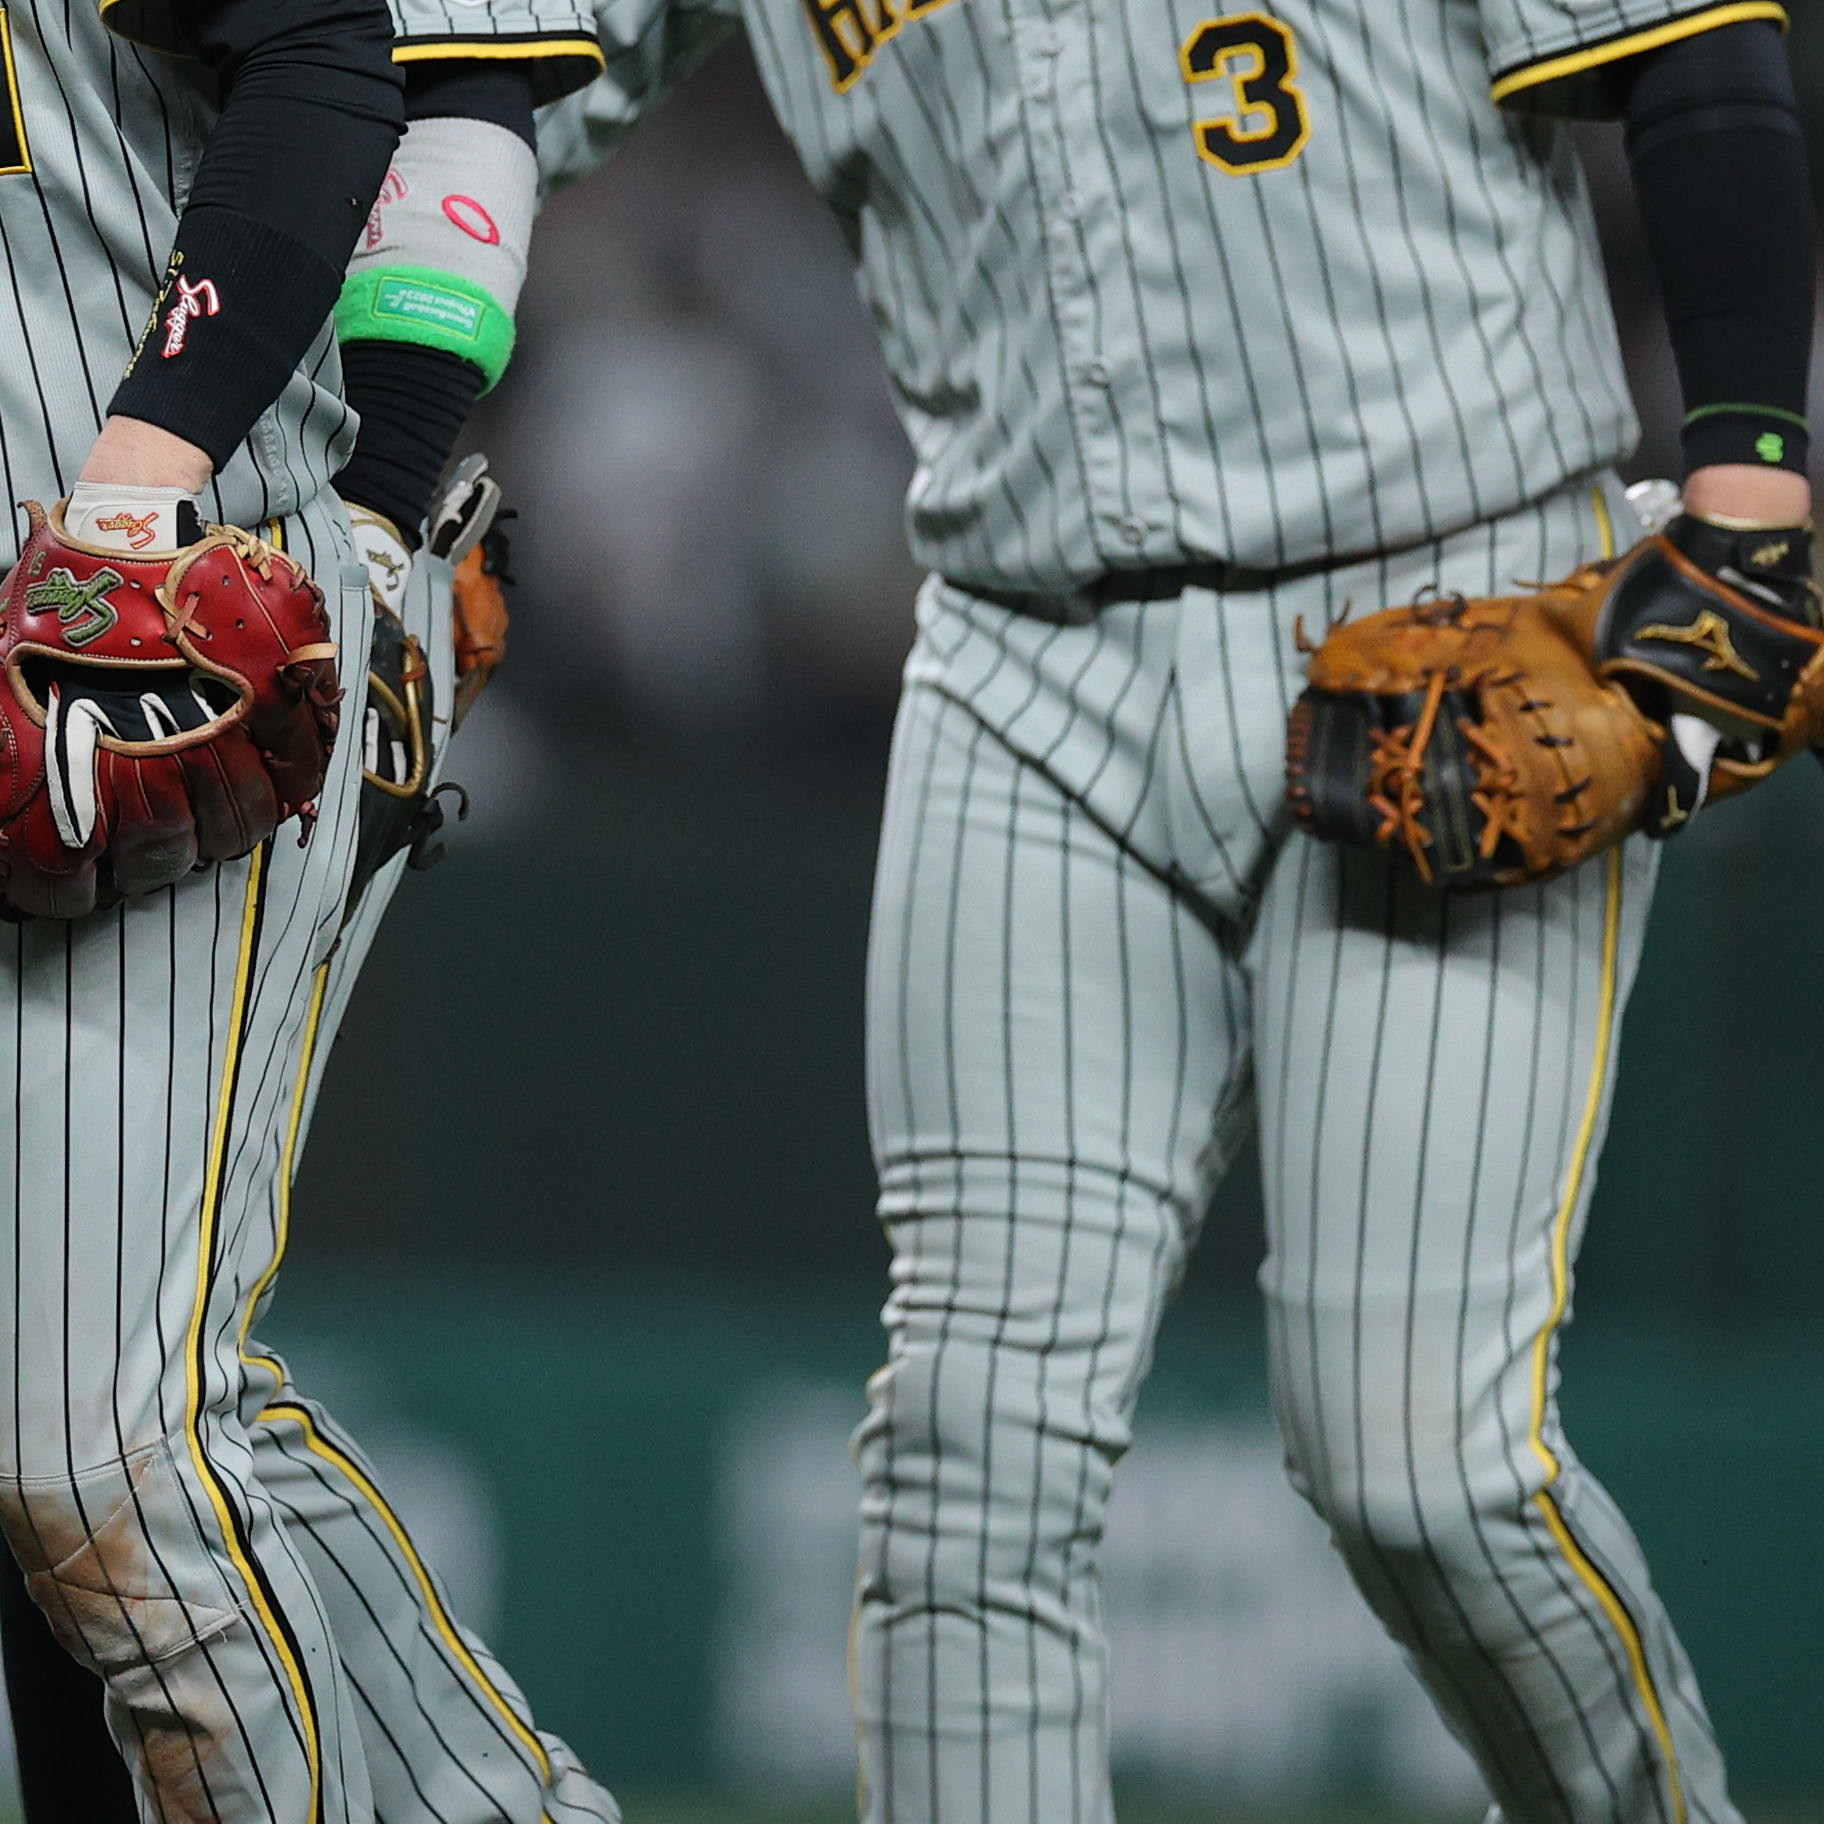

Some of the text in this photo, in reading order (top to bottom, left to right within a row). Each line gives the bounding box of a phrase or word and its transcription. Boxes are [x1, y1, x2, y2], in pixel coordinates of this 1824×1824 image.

[1181, 11, 1311, 177] 3
[160, 274, 222, 358] Slugger
[96, 511, 160, 550] Slugger
